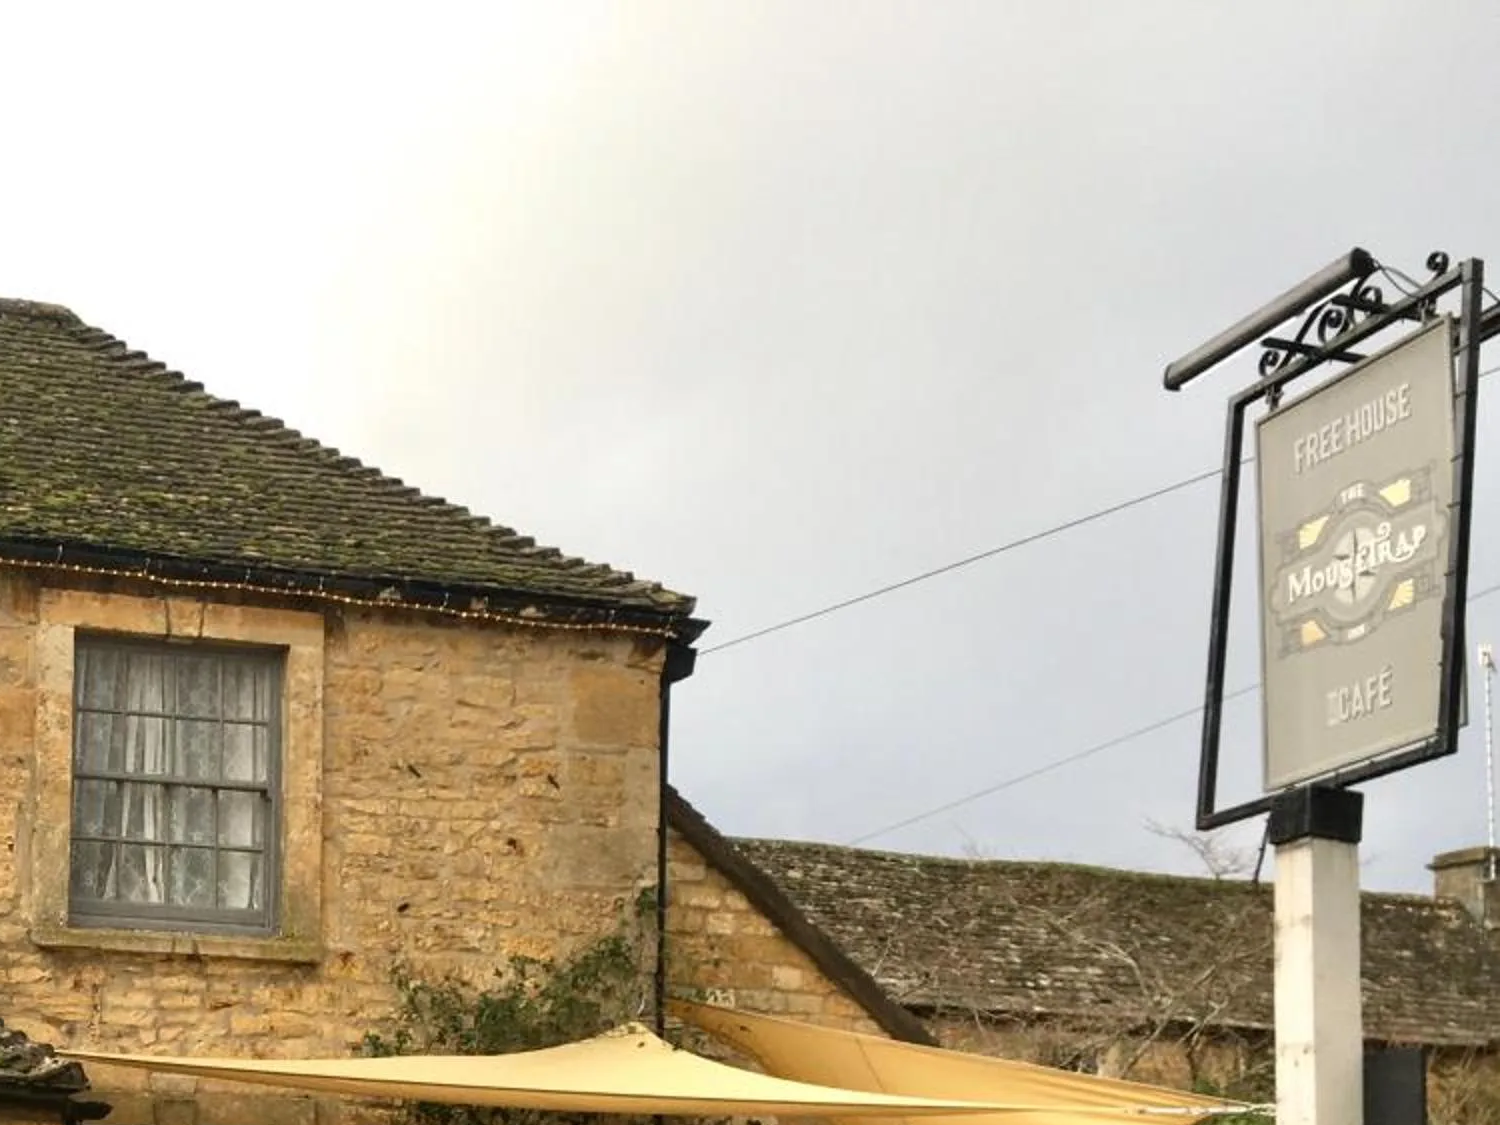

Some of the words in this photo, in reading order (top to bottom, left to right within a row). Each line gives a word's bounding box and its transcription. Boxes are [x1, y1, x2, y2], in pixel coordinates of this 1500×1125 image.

[1293, 417, 1344, 473] FREE
[1345, 382, 1411, 446] HOUSE
[1340, 482, 1365, 505] THE
[1338, 664, 1393, 721] CAFÉ
